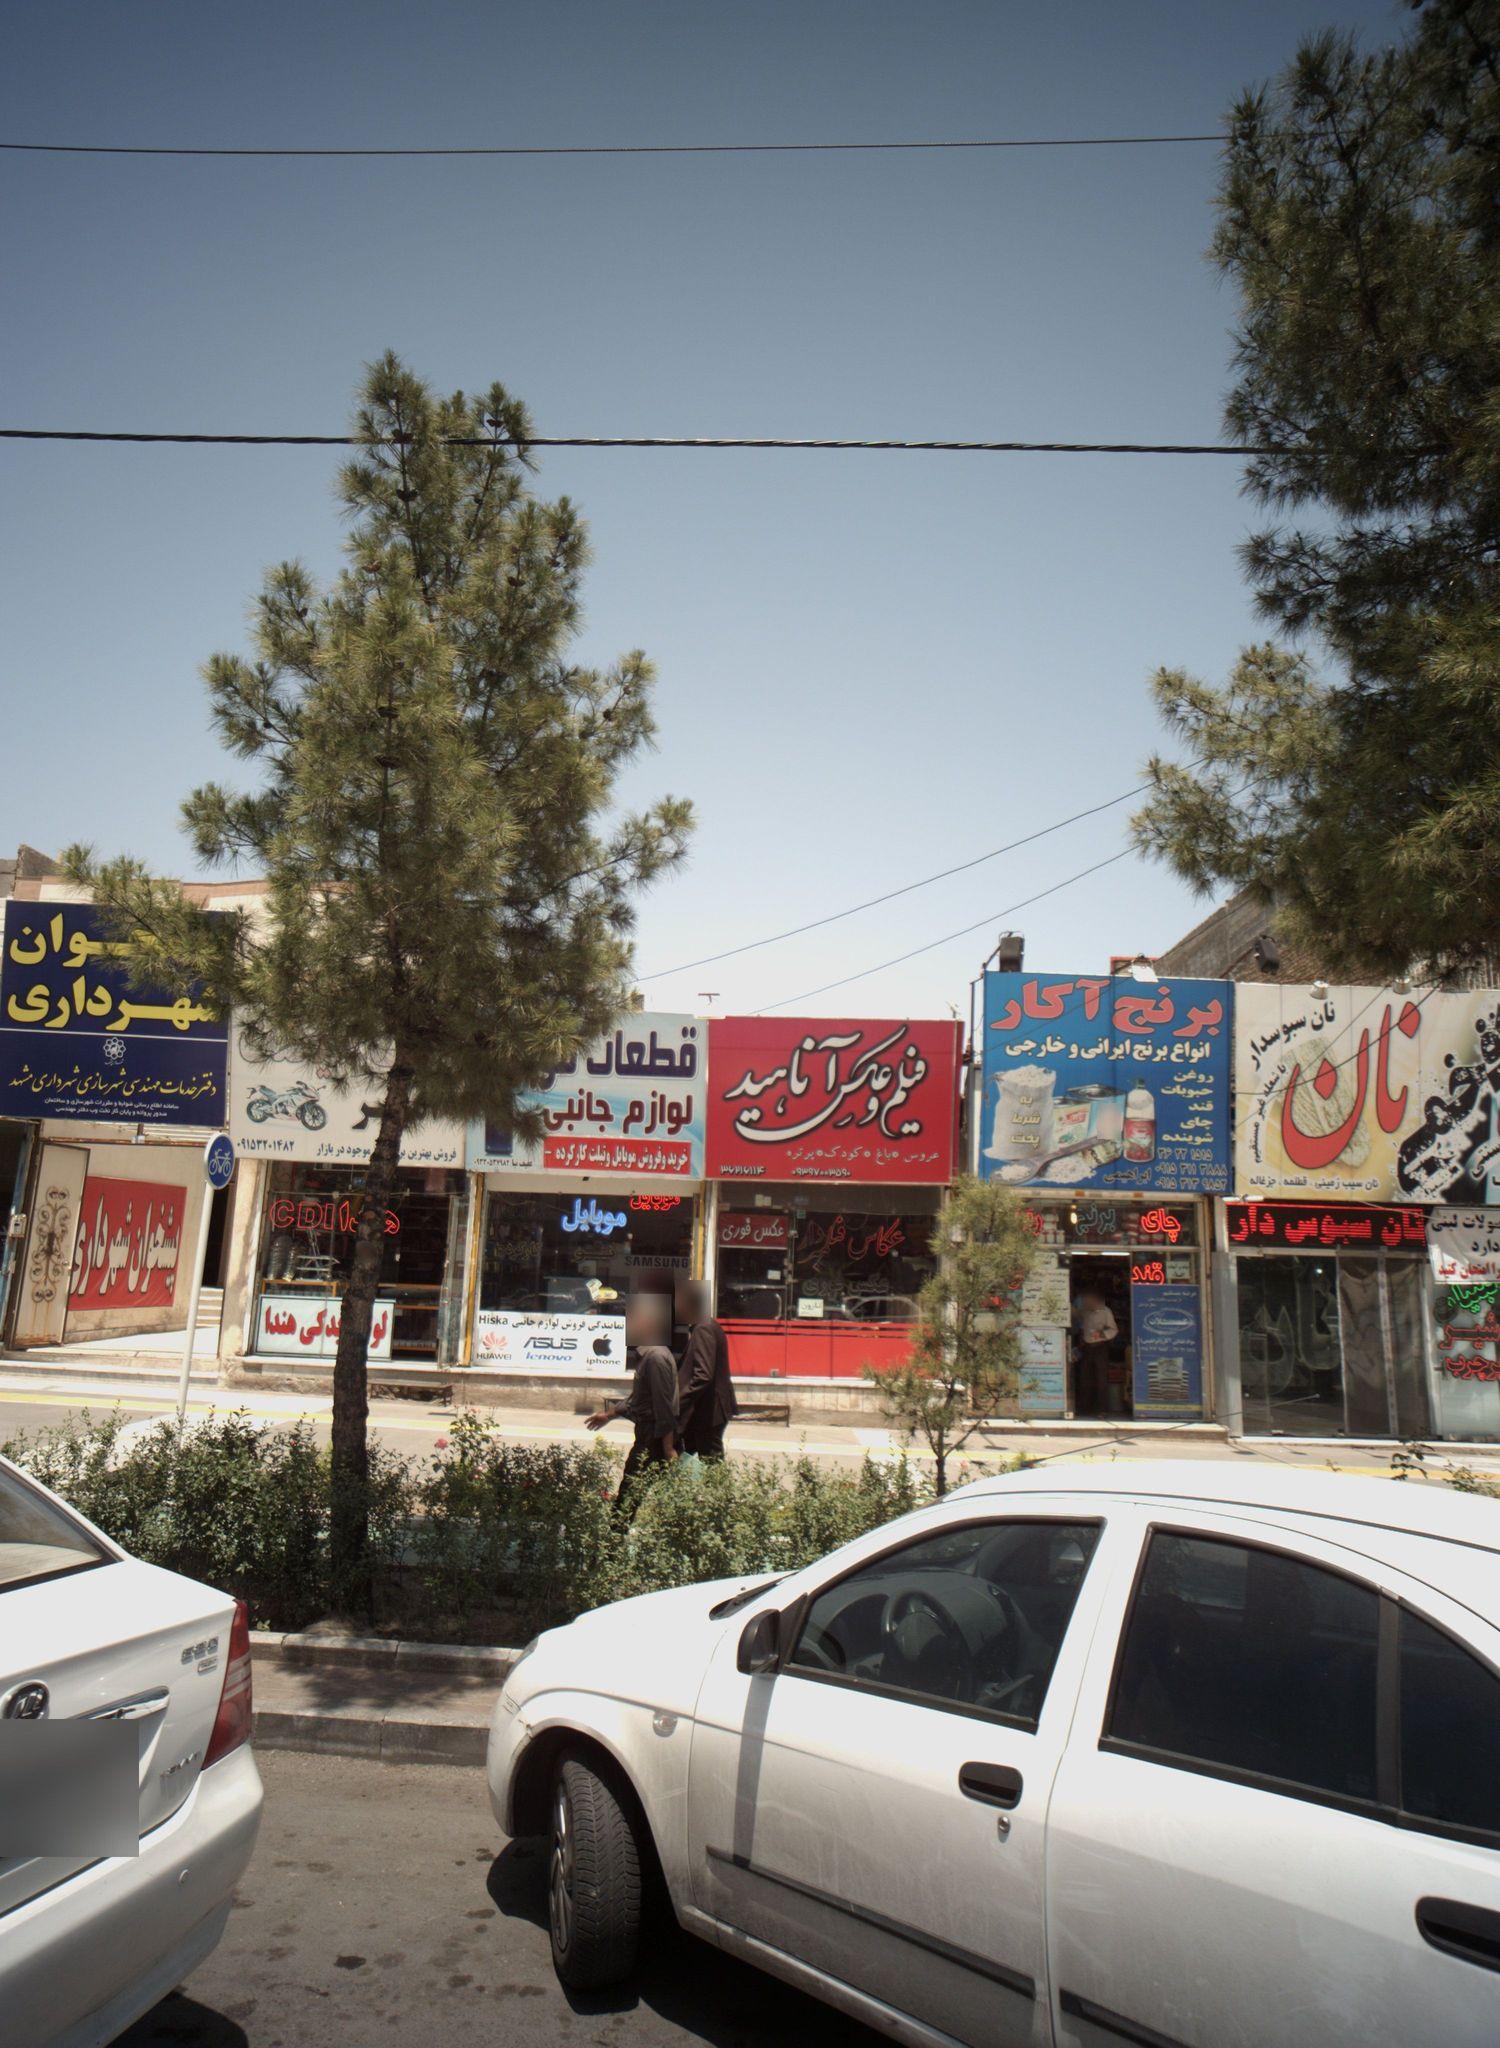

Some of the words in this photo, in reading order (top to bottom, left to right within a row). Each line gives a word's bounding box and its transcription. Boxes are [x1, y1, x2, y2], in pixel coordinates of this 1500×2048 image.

[990, 978, 1111, 1030] آکار
[1112, 986, 1223, 1037] برنج
[1311, 1002, 1335, 1031] نان
[1005, 1034, 1066, 1057] خارجی
[1068, 1044, 1079, 1059] و
[1080, 1038, 1131, 1061] ایرانی
[1131, 1039, 1170, 1061] برنج
[1170, 1041, 1211, 1063] انواع
[9, 1064, 33, 1086] مشهد
[160, 1076, 198, 1096] خدمات
[723, 1031, 863, 1126] آناهید
[735, 1025, 907, 1143] عکس
[1173, 1070, 1214, 1083] روغن
[1281, 1000, 1421, 1170] نان
[877, 1044, 928, 1139] فیلم
[1160, 1085, 1213, 1098] حبوبات
[543, 1087, 615, 1132] جانبی
[622, 1089, 694, 1136] لوازم
[1188, 1101, 1214, 1112] قند
[1161, 1133, 1214, 1146] شوینده
[667, 1148, 689, 1171] خرید
[903, 1151, 940, 1164] عروس
[561, 1197, 627, 1234] موبایل
[1141, 1207, 1182, 1243] چای
[721, 1217, 752, 1242] فوری
[754, 1216, 785, 1243] عکس
[625, 1255, 689, 1269] SAMSUNG
[264, 1305, 297, 1336] هندا
[478, 1314, 509, 1326] Hiska
[523, 1336, 578, 1351] ASUS
[476, 1352, 512, 1361] HUAWEI
[586, 1357, 621, 1366] iphone
